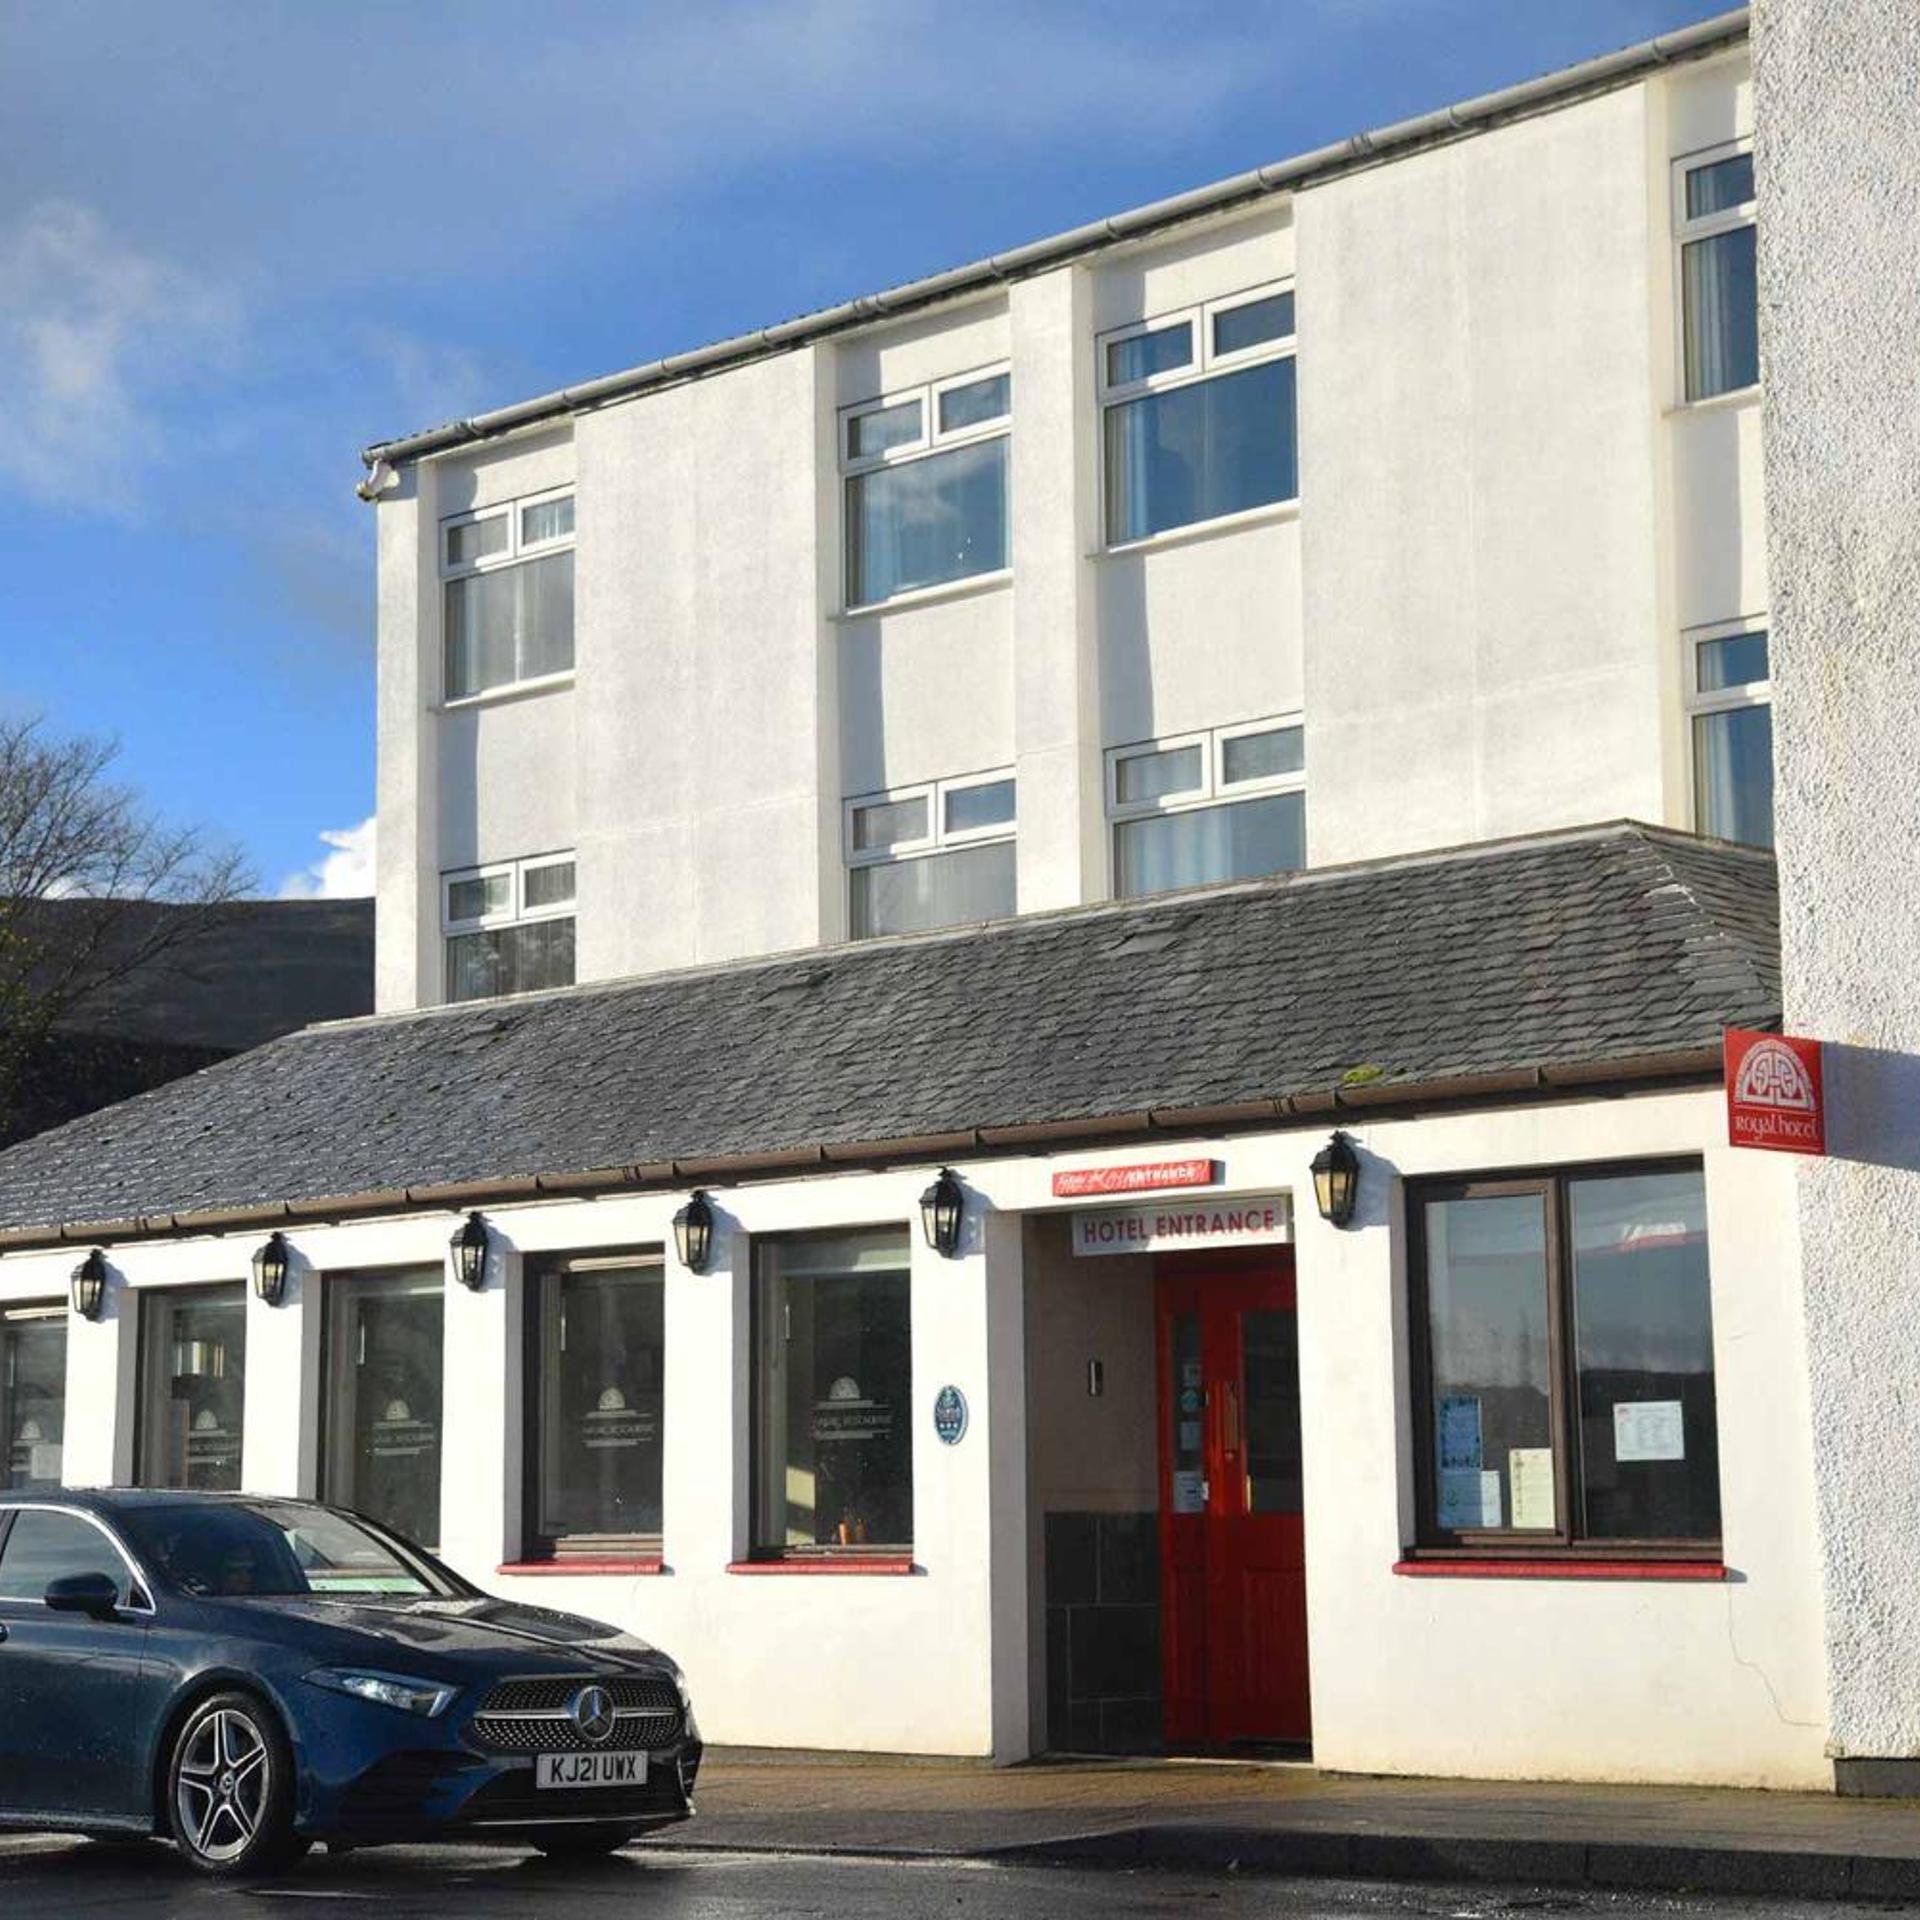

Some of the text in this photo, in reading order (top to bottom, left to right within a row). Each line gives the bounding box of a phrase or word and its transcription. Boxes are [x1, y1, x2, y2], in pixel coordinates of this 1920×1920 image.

[1084, 1210, 1274, 1243] HOTEL ENTRANCE
[551, 1755, 636, 1782] KJ21 UWX
